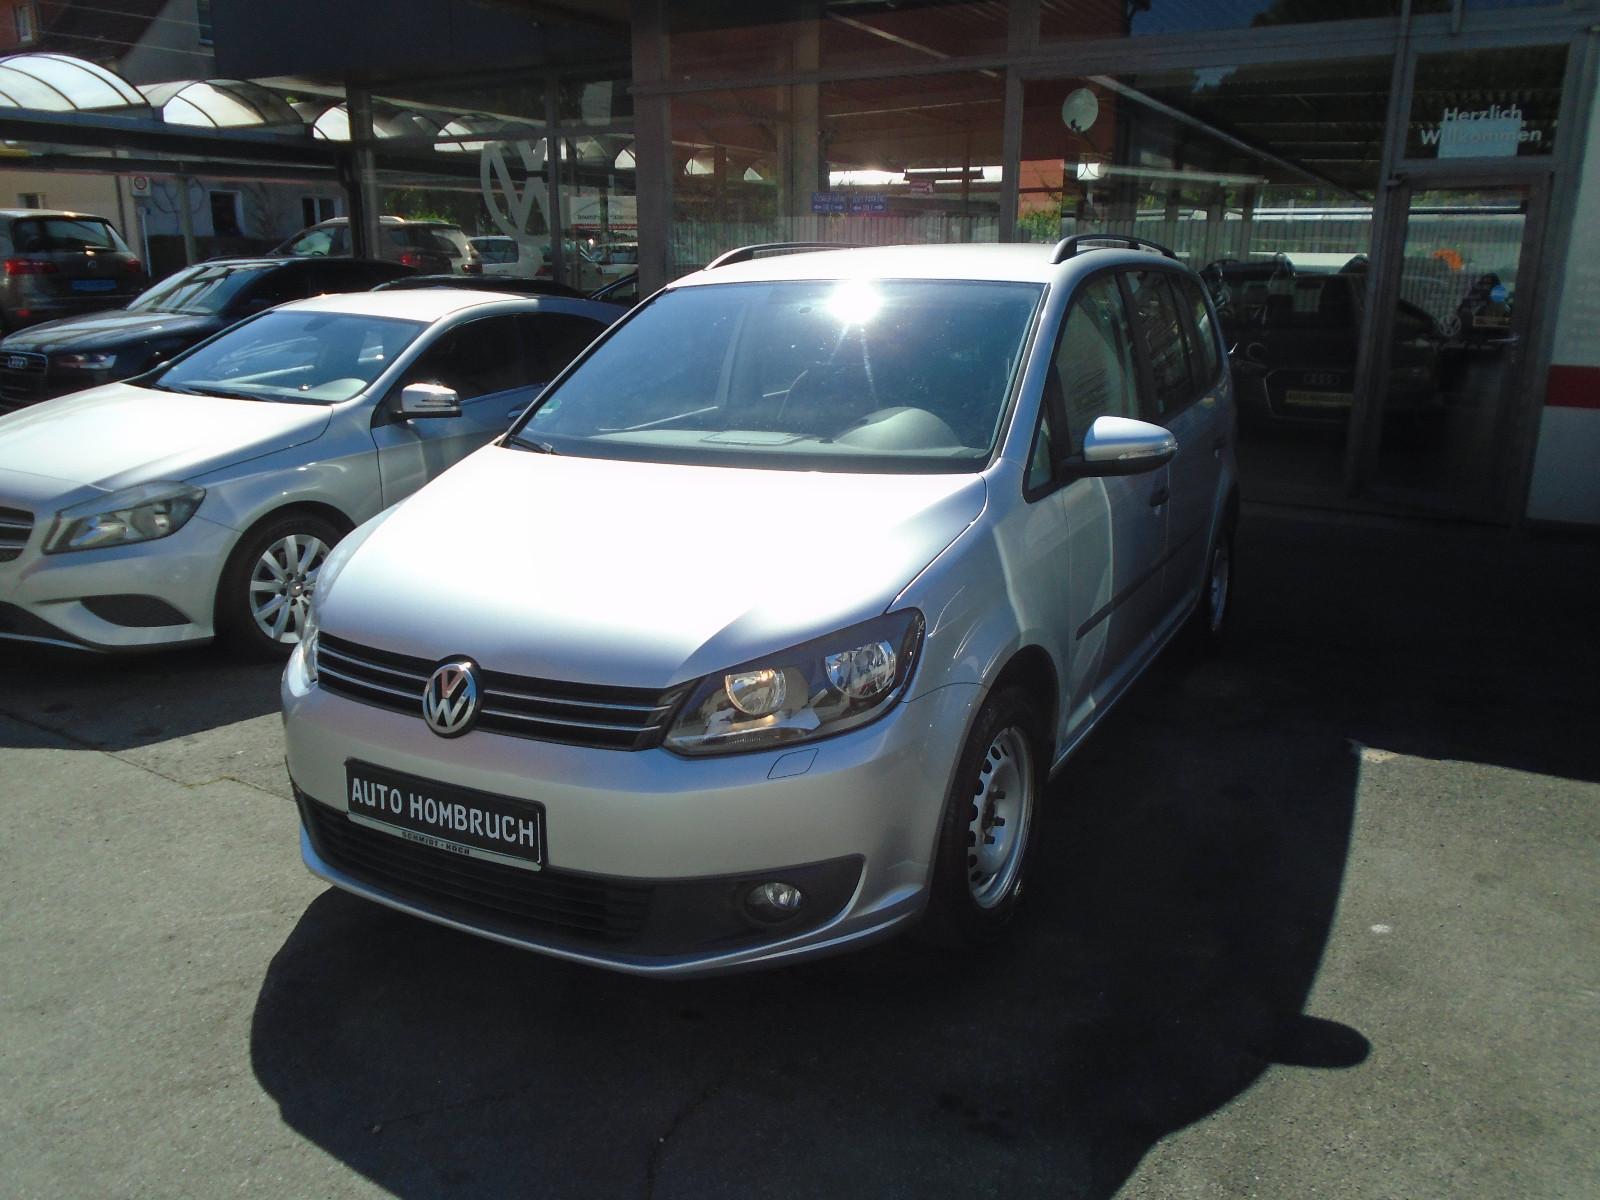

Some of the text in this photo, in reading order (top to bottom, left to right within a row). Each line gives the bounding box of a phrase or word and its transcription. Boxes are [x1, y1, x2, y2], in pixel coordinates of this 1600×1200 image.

[1443, 104, 1523, 121] Herzlich
[351, 777, 535, 847] AUTO HOMBRUCH
